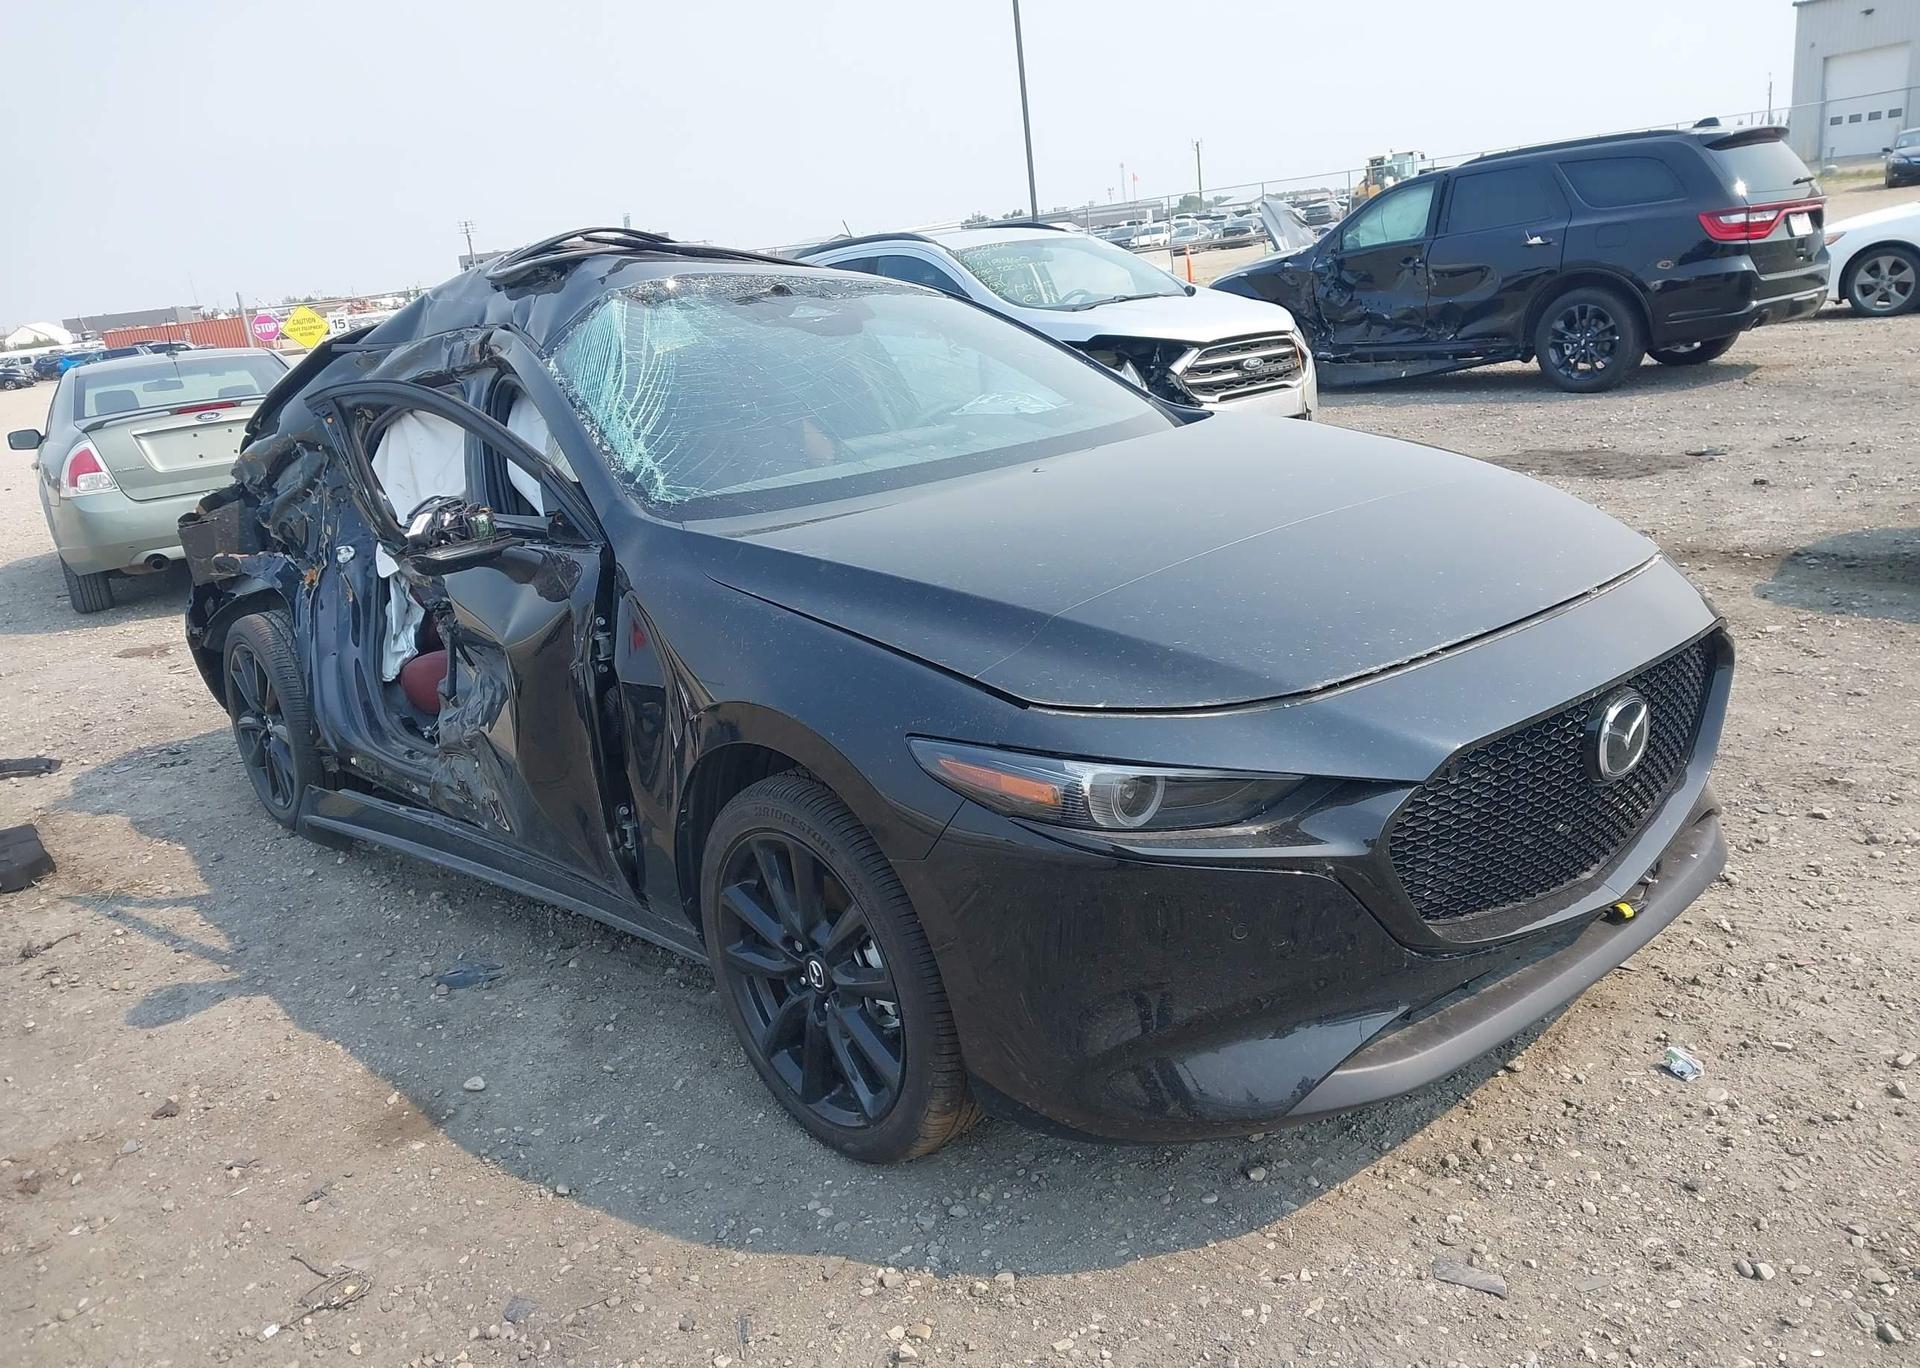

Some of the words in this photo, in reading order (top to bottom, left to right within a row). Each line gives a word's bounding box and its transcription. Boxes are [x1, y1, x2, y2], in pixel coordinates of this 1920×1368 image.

[292, 317, 316, 325] CAUTION
[331, 318, 346, 330] 15
[254, 323, 277, 334] STOP
[754, 806, 838, 858] BRIDGESTONE
